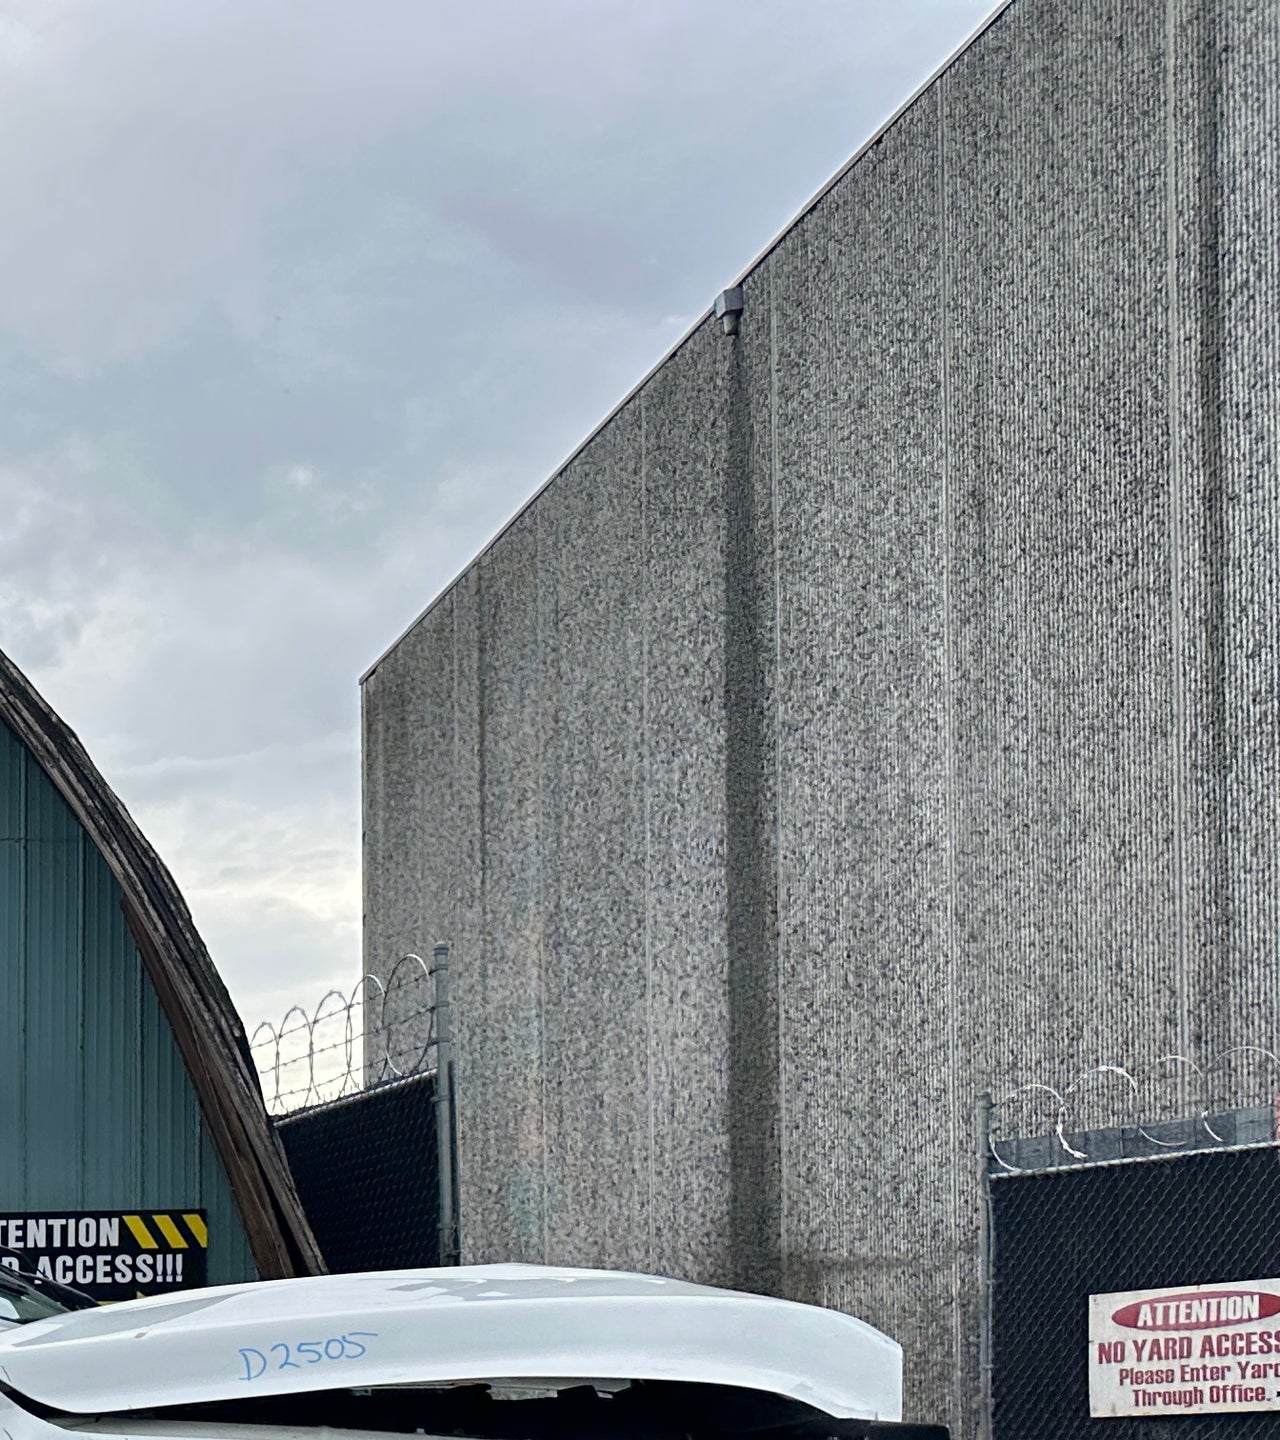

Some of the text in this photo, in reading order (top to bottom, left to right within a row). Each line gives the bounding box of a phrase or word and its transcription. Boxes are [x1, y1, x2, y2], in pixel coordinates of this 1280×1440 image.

[33, 1253, 184, 1285] ACCESS!!!
[1136, 1294, 1260, 1327] ATTENTION
[238, 1331, 379, 1382] D2505
[1097, 1341, 1126, 1365] NO
[1132, 1336, 1192, 1363] YARD
[1119, 1368, 1175, 1386] Please
[1180, 1365, 1231, 1383] Enter
[1132, 1384, 1272, 1408] Through Office.
